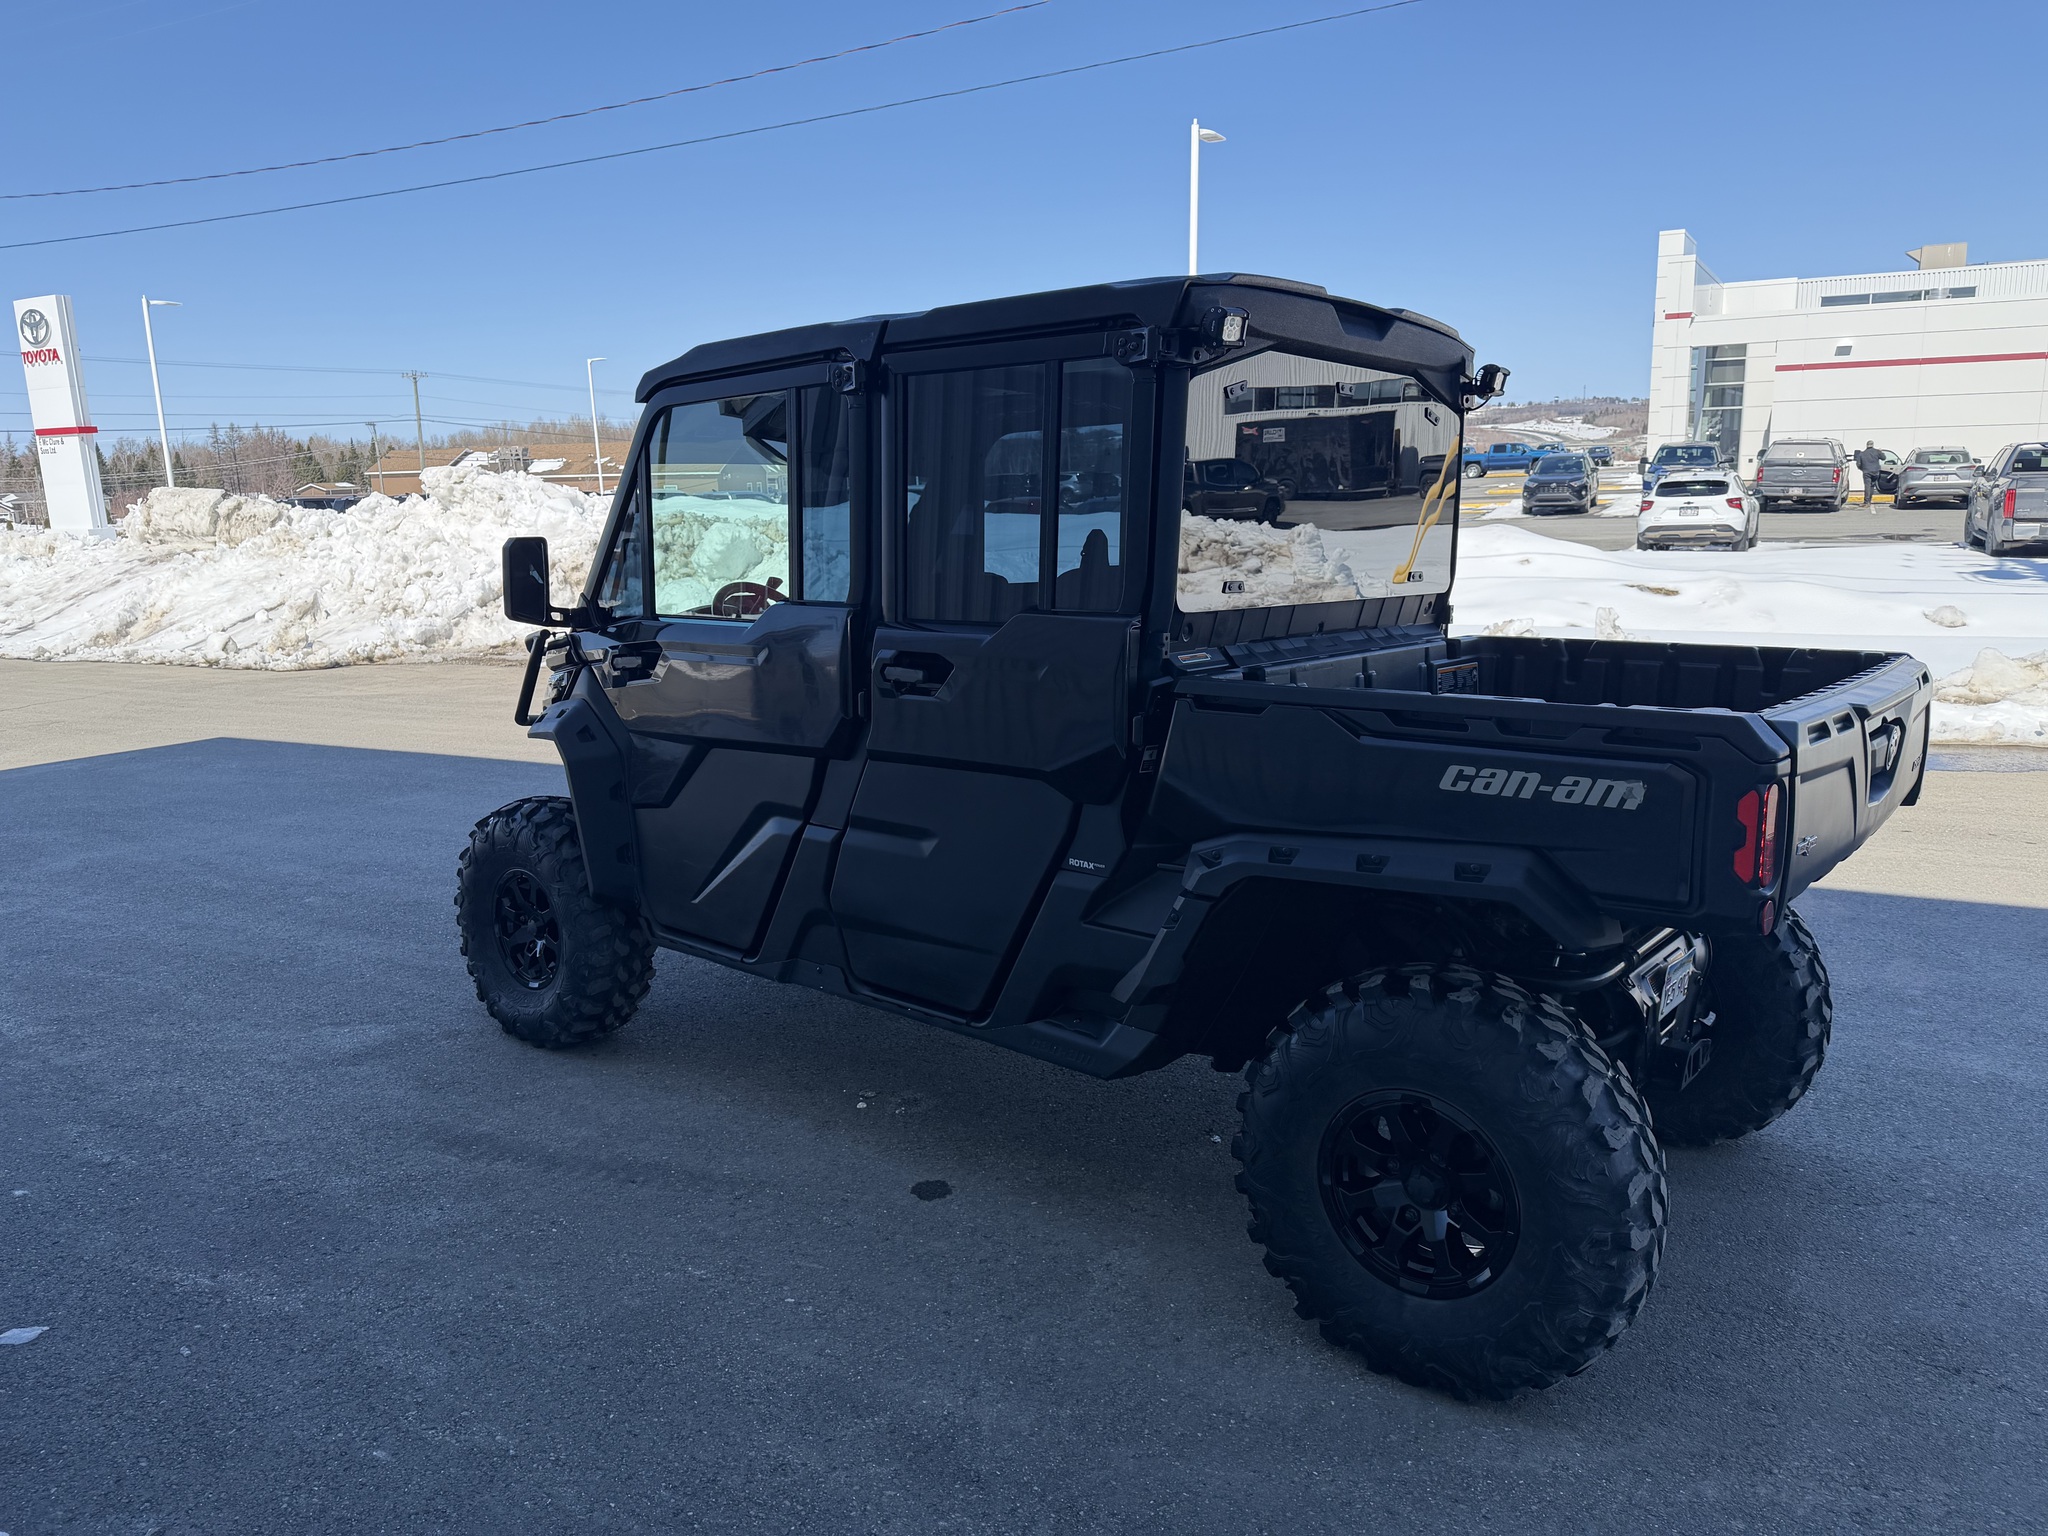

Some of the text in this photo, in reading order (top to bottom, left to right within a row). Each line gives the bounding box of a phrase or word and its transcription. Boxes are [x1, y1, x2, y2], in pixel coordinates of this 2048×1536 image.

[21, 348, 61, 364] TOYOTA
[1438, 764, 1647, 811] can-am
[1068, 858, 1095, 870] ROTAX
